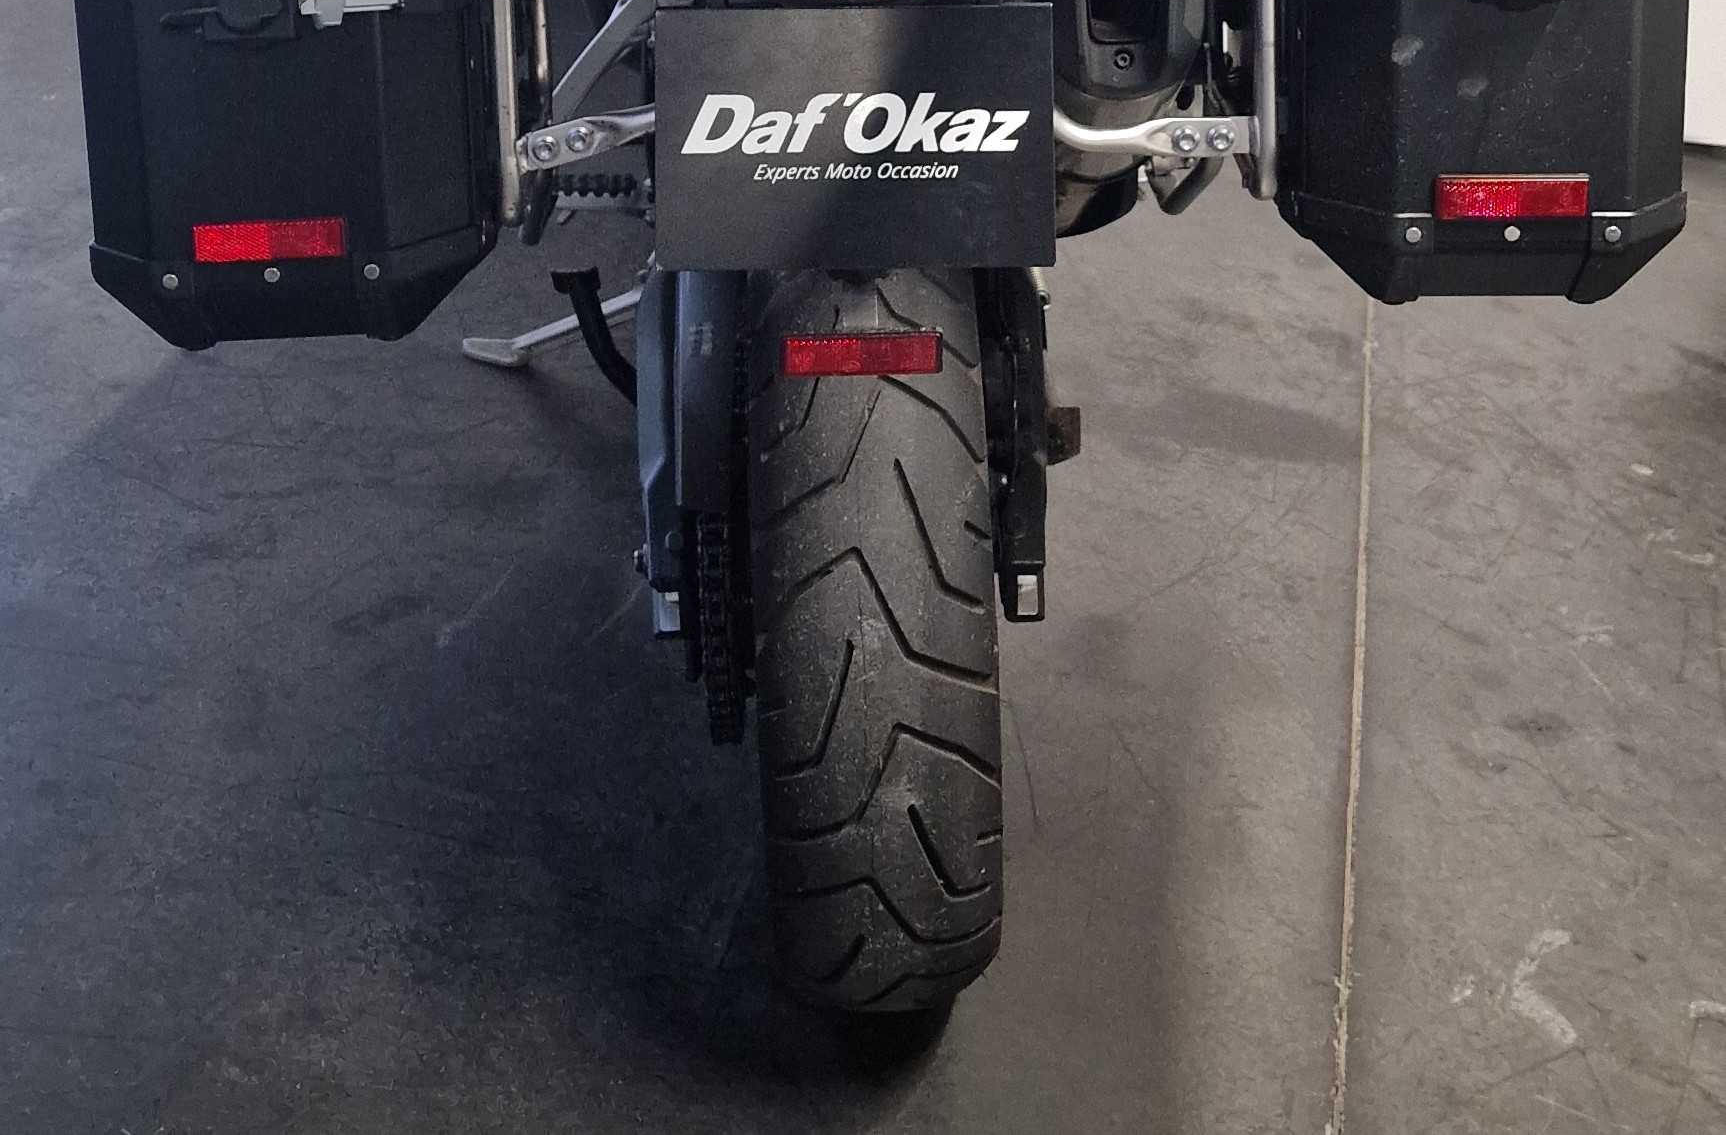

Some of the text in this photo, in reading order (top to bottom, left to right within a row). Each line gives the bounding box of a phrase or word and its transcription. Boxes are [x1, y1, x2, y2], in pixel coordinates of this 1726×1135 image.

[753, 162, 959, 185] Experts Moto Occasion
